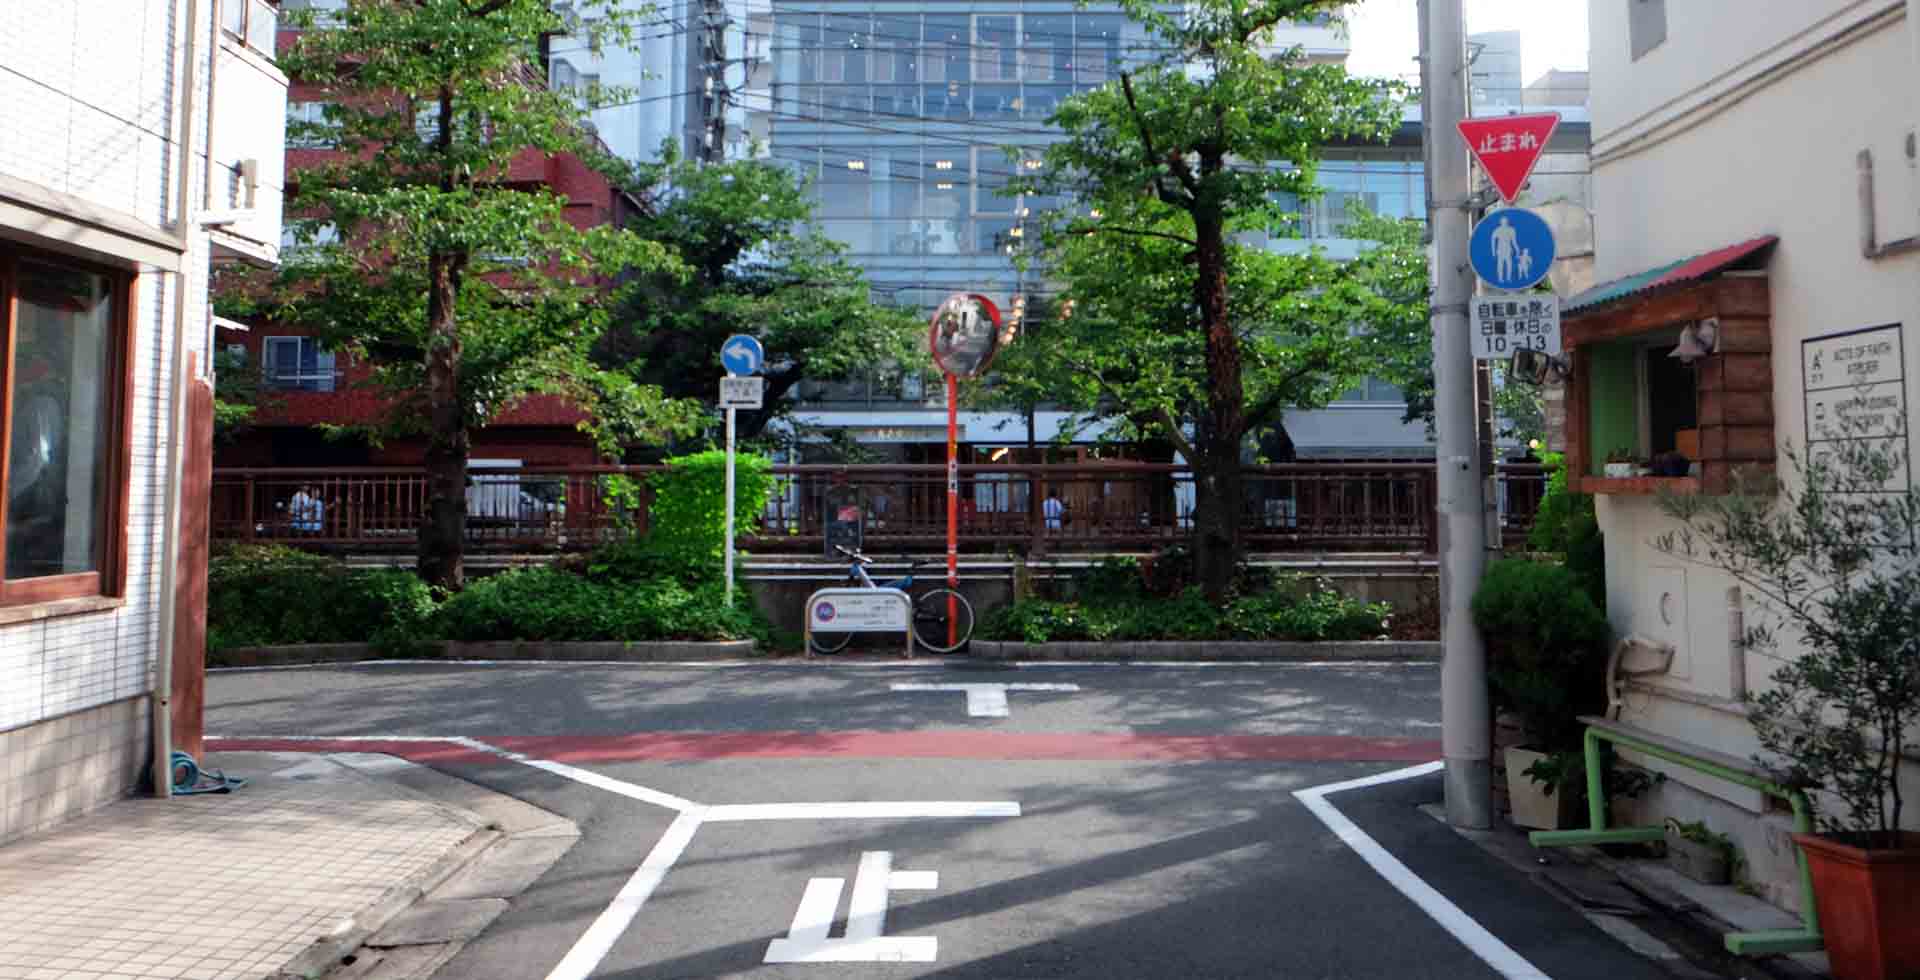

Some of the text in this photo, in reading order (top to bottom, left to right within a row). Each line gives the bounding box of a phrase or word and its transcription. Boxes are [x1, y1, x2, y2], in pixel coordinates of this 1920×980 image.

[1478, 131, 1539, 154] 止まれ
[1479, 302, 1552, 319] 自転車を除く
[763, 850, 938, 964] 止
